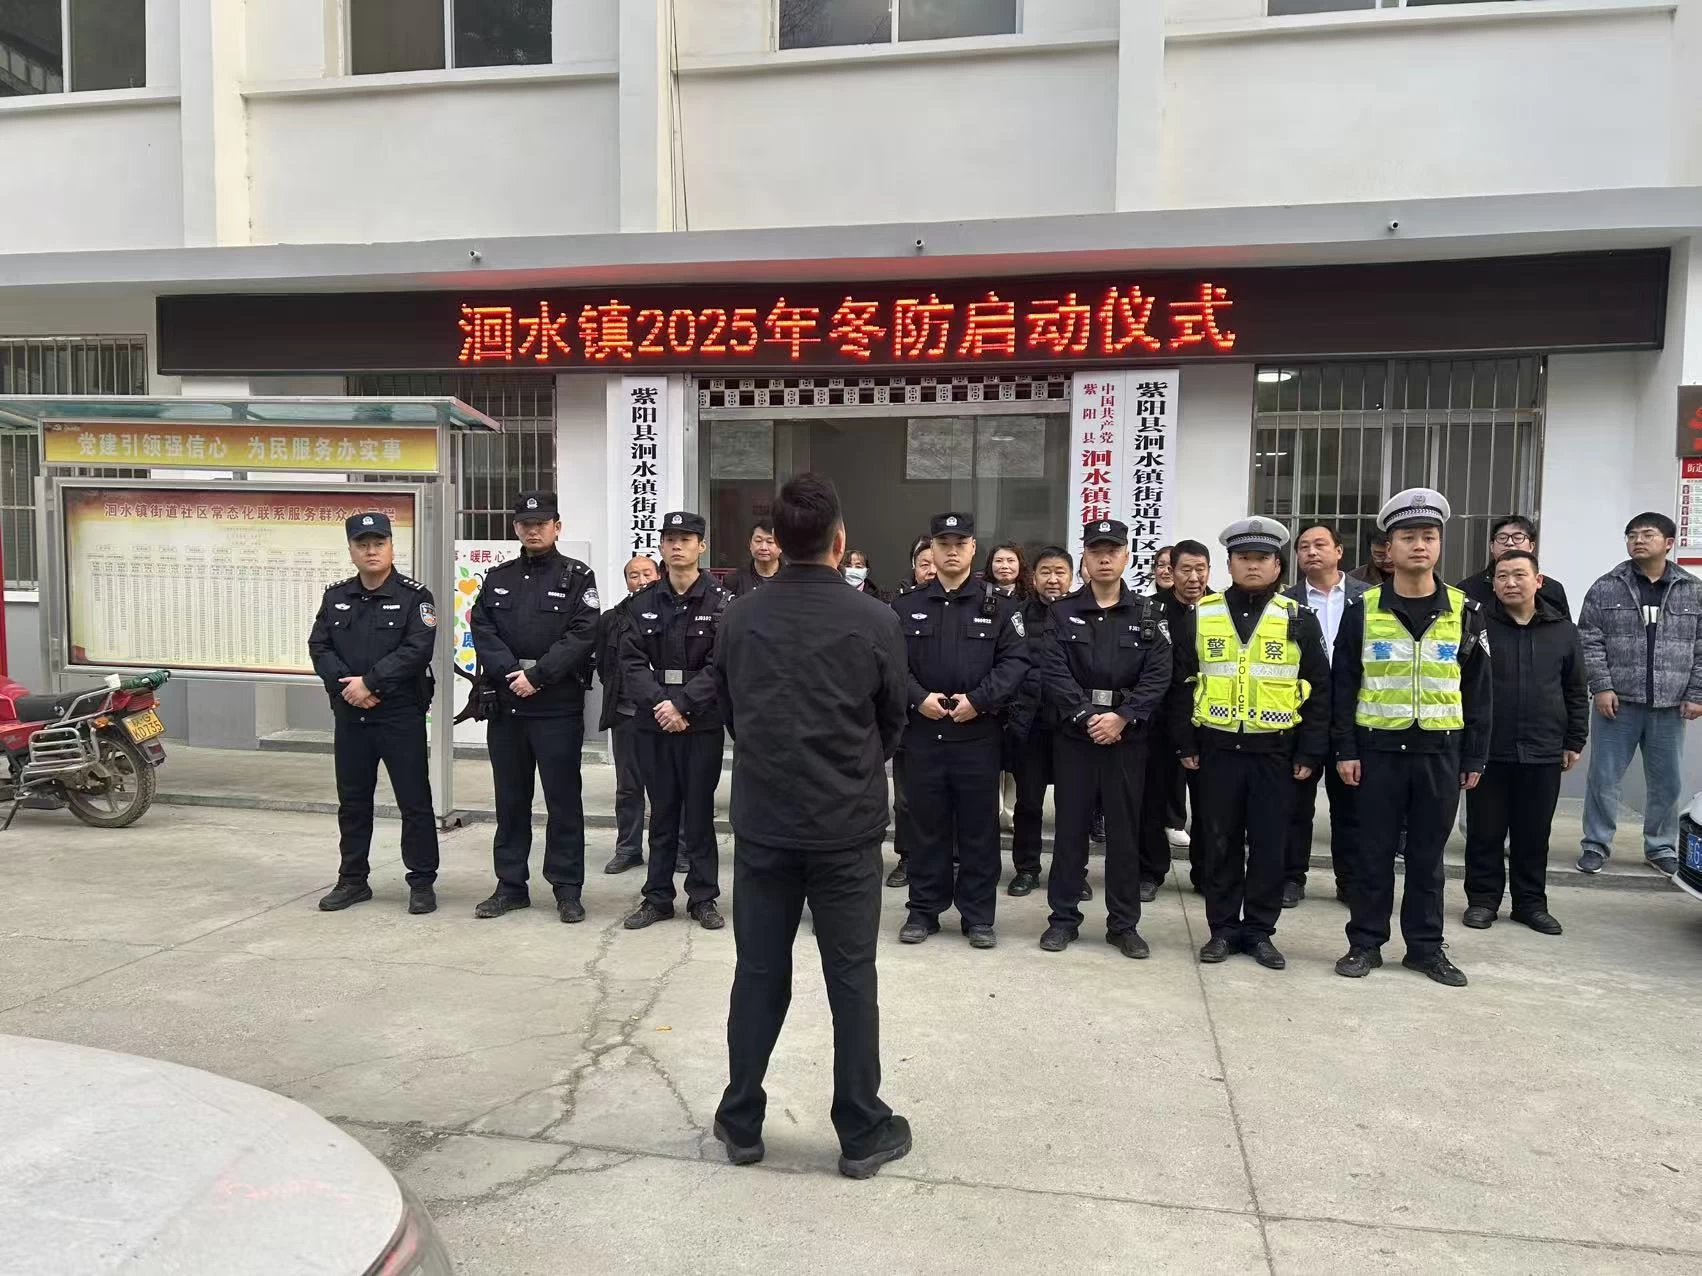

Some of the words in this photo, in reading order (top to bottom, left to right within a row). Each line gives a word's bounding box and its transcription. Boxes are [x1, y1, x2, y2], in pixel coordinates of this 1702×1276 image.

[457, 282, 1238, 361] 洄水镇2025年冬防启动仪式
[1082, 383, 1098, 444] 紫阳县
[1099, 382, 1115, 445] 中国共产党
[78, 432, 229, 459] 党建引领强信心
[247, 436, 402, 462] 为民服务办实事
[630, 386, 659, 559] 紫阳县洄水镇街道社
[1079, 449, 1113, 541] 洄水镇街
[1207, 638, 1226, 657] 警
[1264, 640, 1284, 660] 察
[1238, 656, 1247, 714] POLICE
